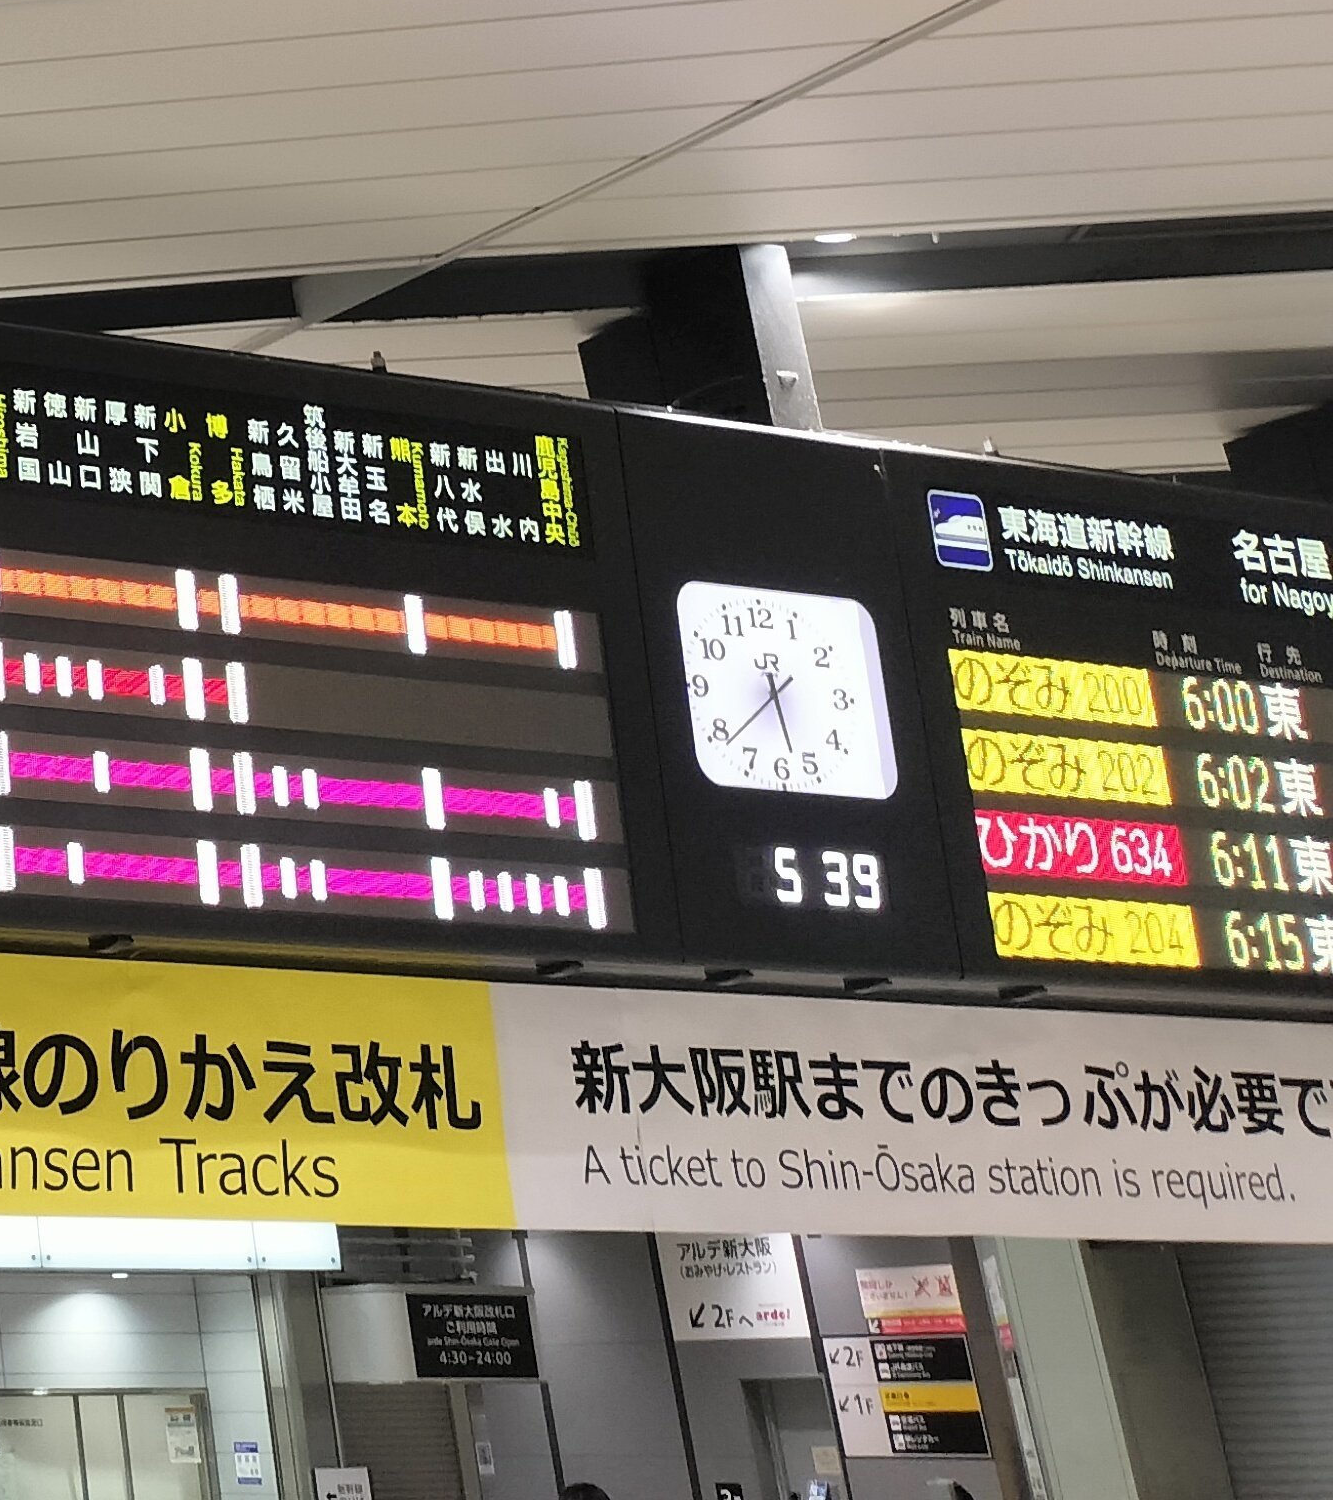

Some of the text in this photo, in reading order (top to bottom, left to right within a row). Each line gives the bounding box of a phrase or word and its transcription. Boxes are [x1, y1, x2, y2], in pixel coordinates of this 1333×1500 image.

[13, 388, 41, 483] 新岩国
[188, 442, 203, 502] Kokura
[230, 447, 246, 507] Hakata
[277, 422, 305, 515] 久留米
[430, 443, 459, 533] 新八代
[485, 450, 513, 540] 出水
[512, 452, 540, 542] 川内
[535, 435, 566, 546] 鹿児島中央
[997, 505, 1175, 561] 東海道新幹線
[1078, 562, 1174, 590] Shinkansen
[1240, 577, 1268, 605] for
[722, 615, 745, 636] 11
[747, 607, 774, 630] 12
[952, 628, 1021, 651] Train Name
[700, 638, 726, 661] 10
[754, 653, 780, 673] JR
[1155, 650, 1243, 675] Departure Time
[1259, 663, 1324, 684] Destination
[692, 675, 709, 698] 9
[833, 689, 848, 709] 3
[952, 658, 1149, 718] のぞみ 200
[1182, 673, 1258, 734] 6:00
[773, 757, 790, 781] 6
[967, 737, 1156, 796] のぞみ 202
[1196, 752, 1275, 814] 6:02
[978, 815, 1173, 878] ひかり 634
[1211, 831, 1288, 892] 6:11
[994, 904, 1185, 956] のぞみ 204
[1226, 912, 1306, 973] 6:15
[160, 1137, 339, 1199] Tracks
[583, 1144, 1296, 1209] A ticket to Shin-Ōsaka station is required.
